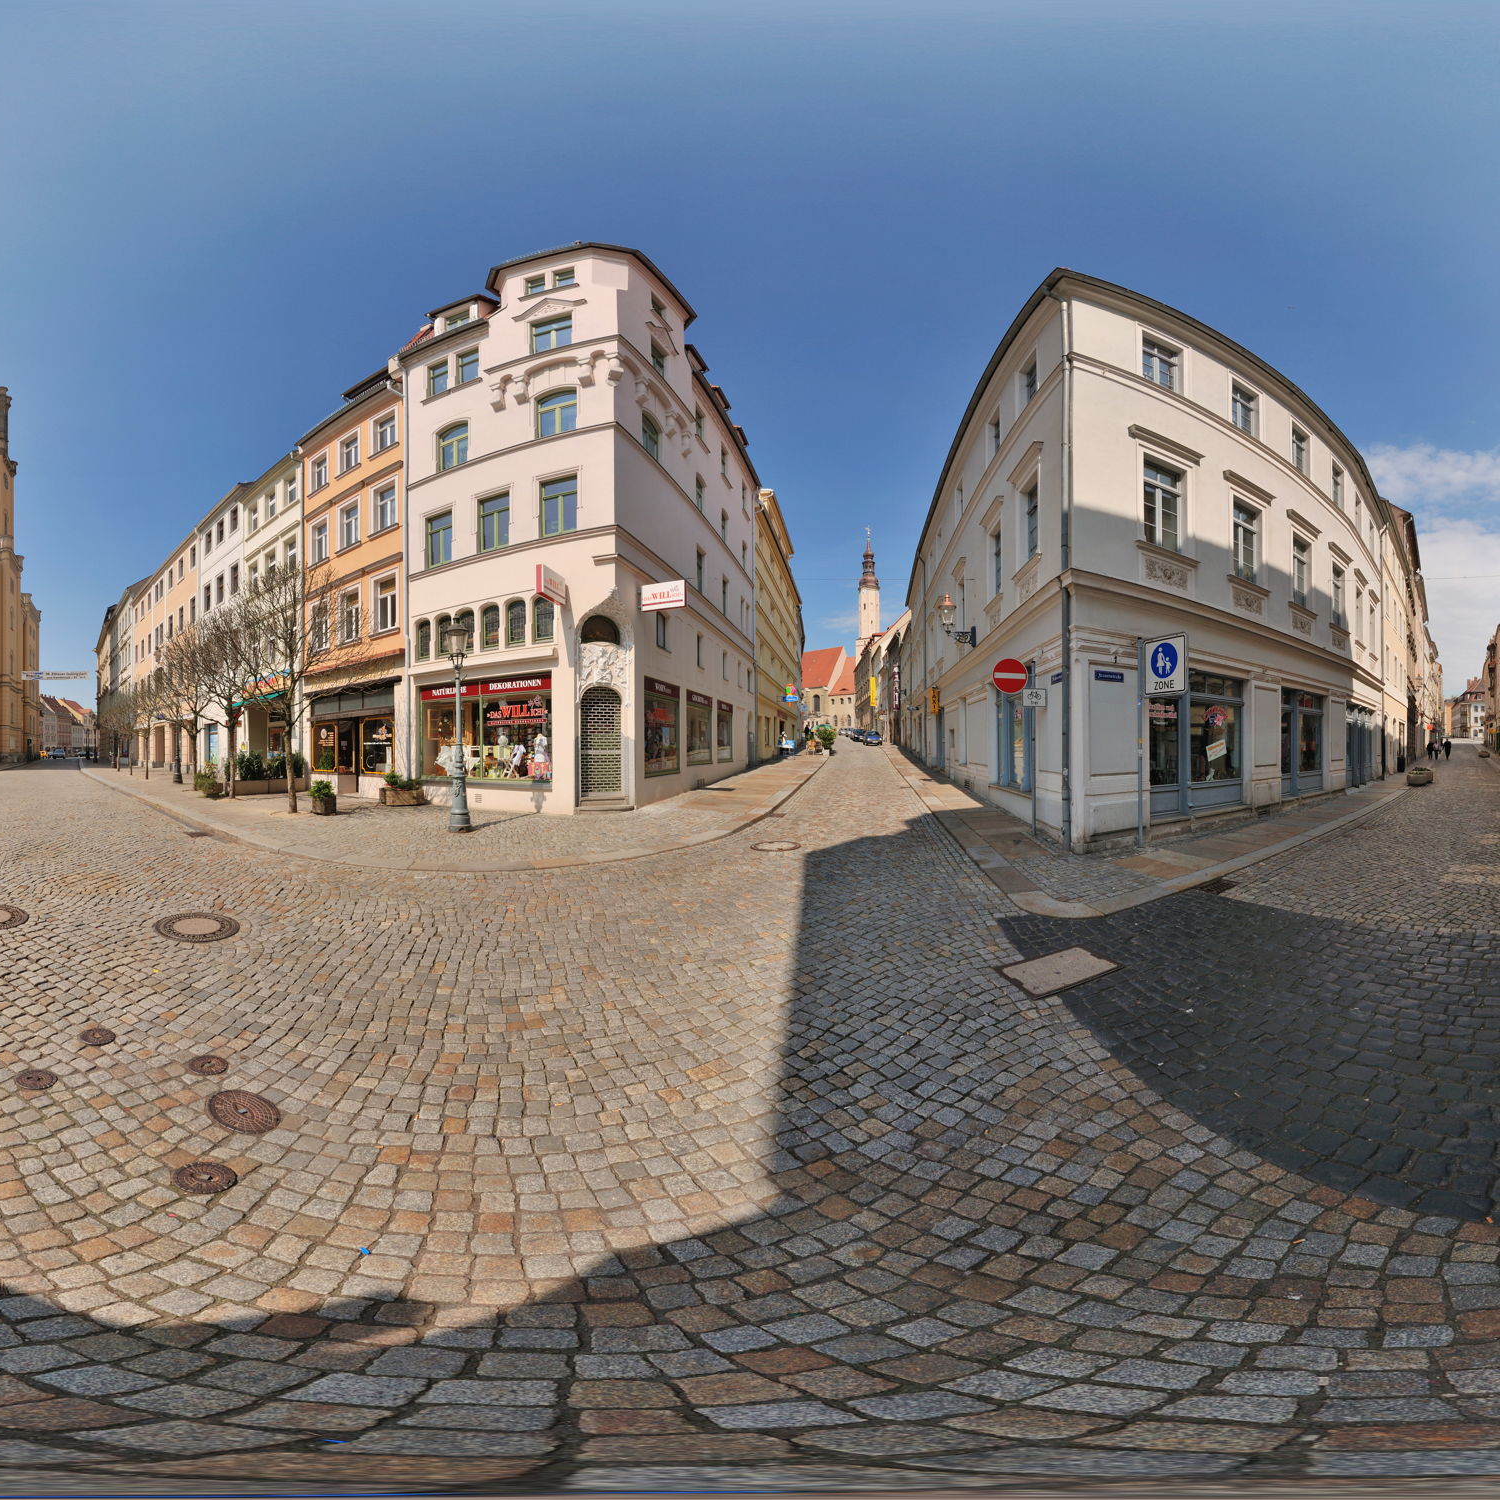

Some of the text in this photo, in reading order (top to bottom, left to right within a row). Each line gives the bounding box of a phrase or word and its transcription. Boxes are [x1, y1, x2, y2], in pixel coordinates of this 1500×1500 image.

[651, 592, 672, 600] WILL
[432, 679, 542, 697] NATÜRLIHE DEKORATIONEN
[1154, 680, 1175, 691] ZONE
[500, 704, 530, 718] WILL
